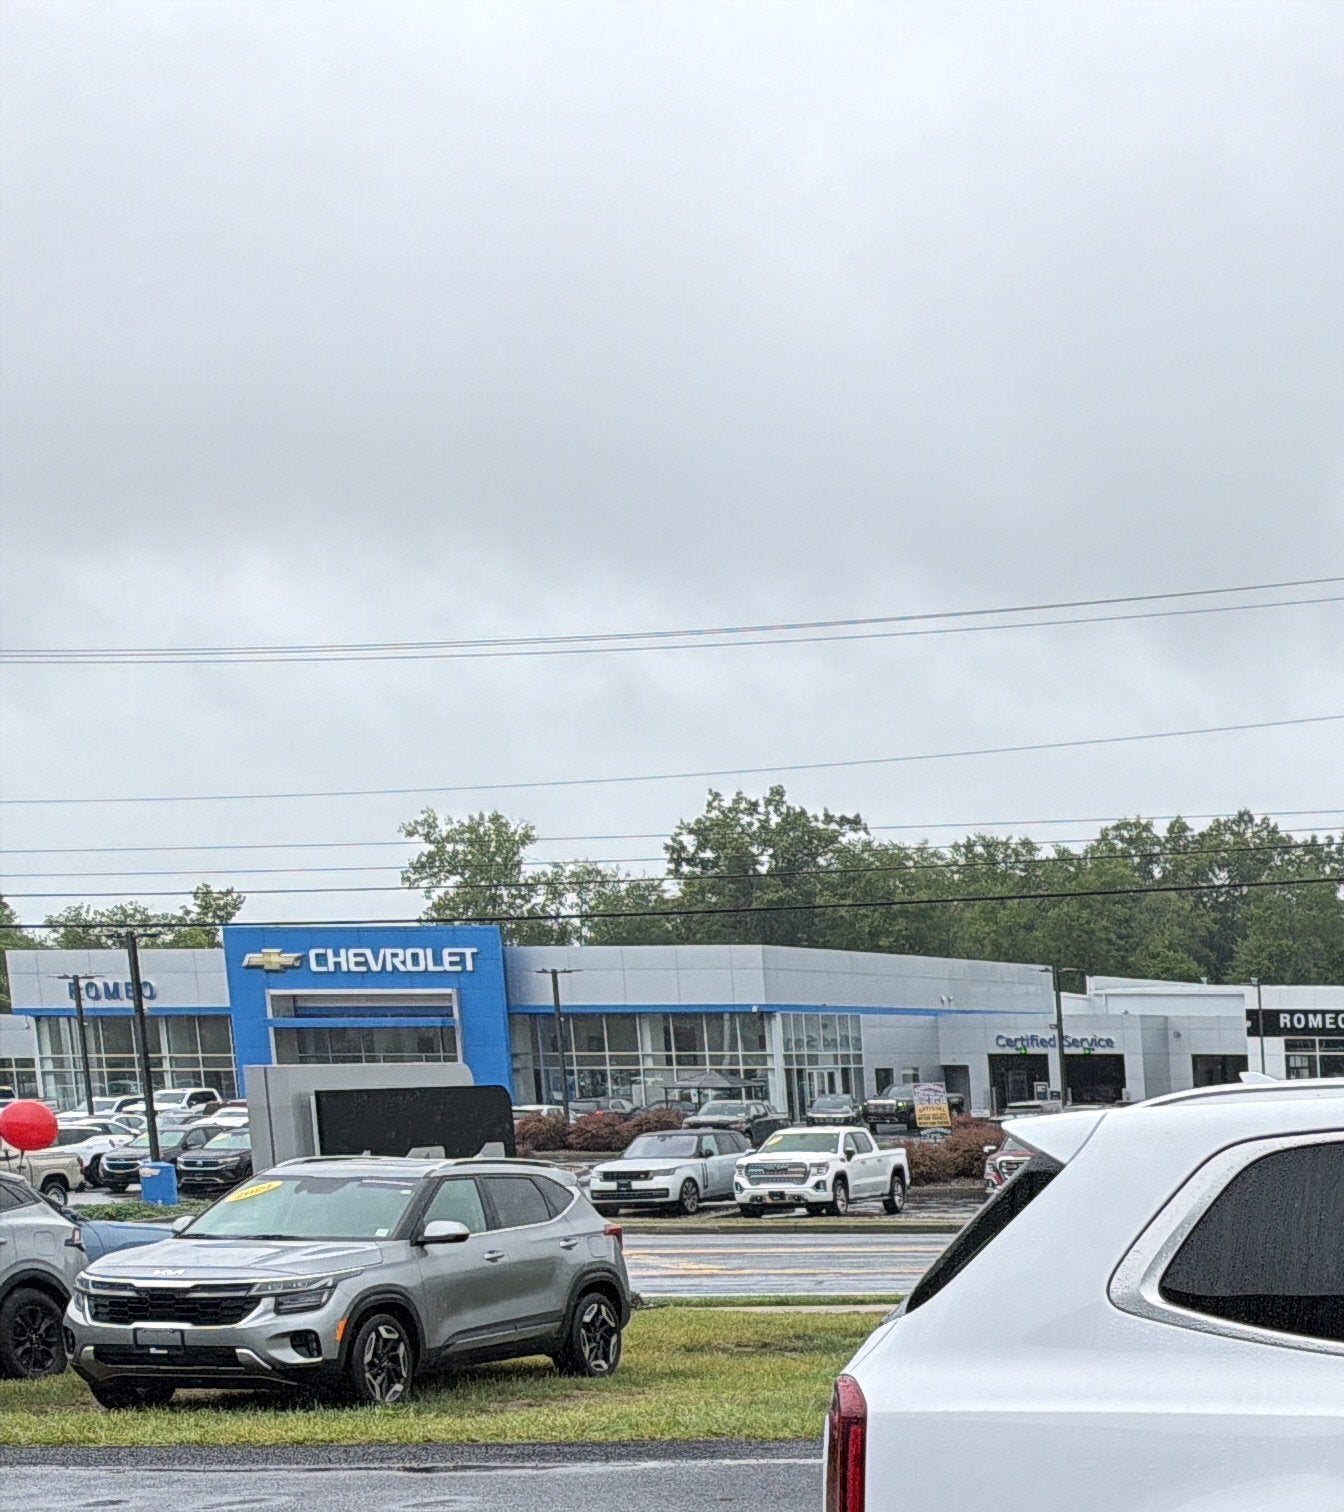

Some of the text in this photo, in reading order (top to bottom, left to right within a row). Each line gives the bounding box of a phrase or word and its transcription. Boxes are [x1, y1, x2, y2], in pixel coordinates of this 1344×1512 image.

[308, 947, 479, 972] CHEVROLET
[995, 1033, 1115, 1049] Certified Service
